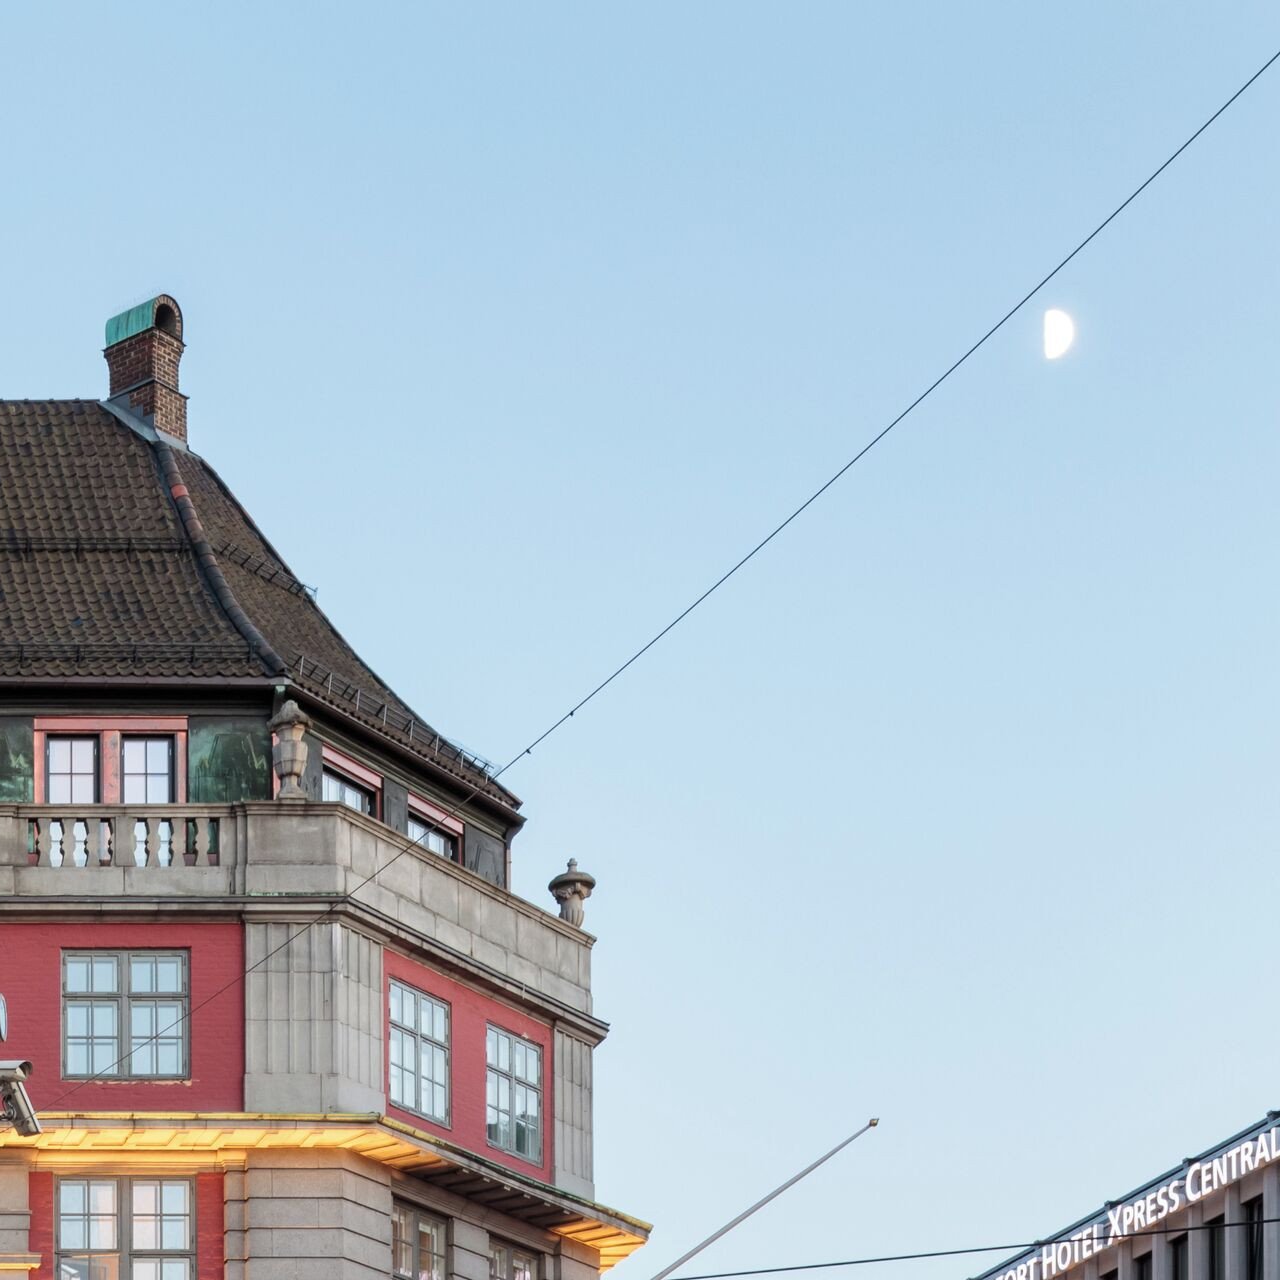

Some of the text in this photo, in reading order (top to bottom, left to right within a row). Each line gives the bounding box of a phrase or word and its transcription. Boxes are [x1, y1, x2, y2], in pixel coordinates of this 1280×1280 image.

[1042, 1223, 1103, 1280] HOTEL
[1107, 1180, 1180, 1247] XPRESS
[1185, 1126, 1280, 1201] CENTRAL
